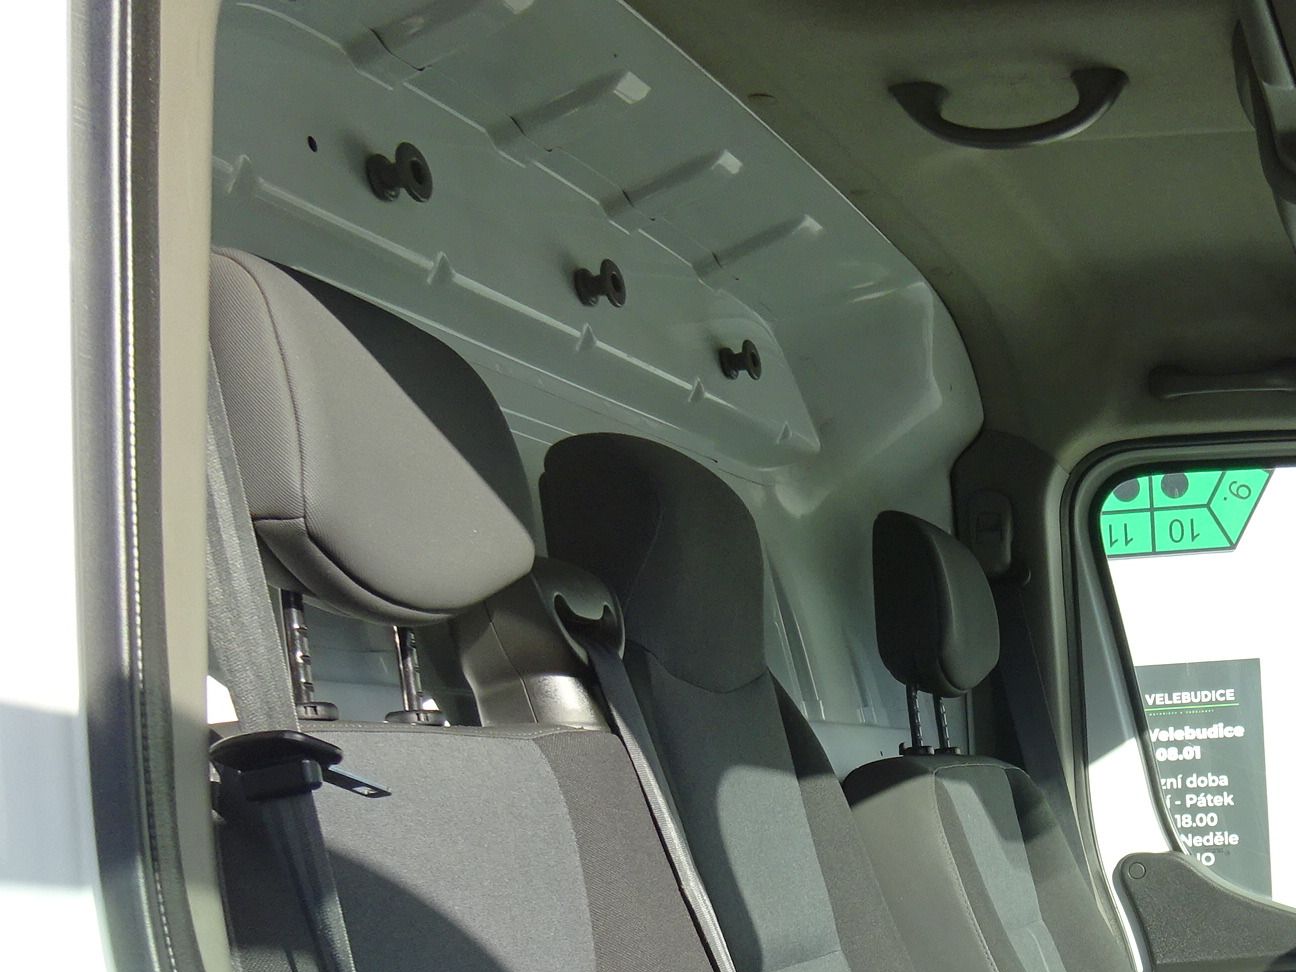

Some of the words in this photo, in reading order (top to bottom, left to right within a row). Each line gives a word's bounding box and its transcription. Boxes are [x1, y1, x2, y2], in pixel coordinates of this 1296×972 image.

[1108, 522, 1134, 548] 11
[1169, 518, 1201, 543] 10
[1145, 688, 1235, 706] VELEBUDICE
[1149, 722, 1245, 742] Velebudice
[1155, 745, 1202, 761] 08.01
[1185, 772, 1229, 788] doba
[1185, 791, 1235, 808] Pátek
[1174, 812, 1218, 828] 18.00
[1180, 830, 1240, 847] Neděle
